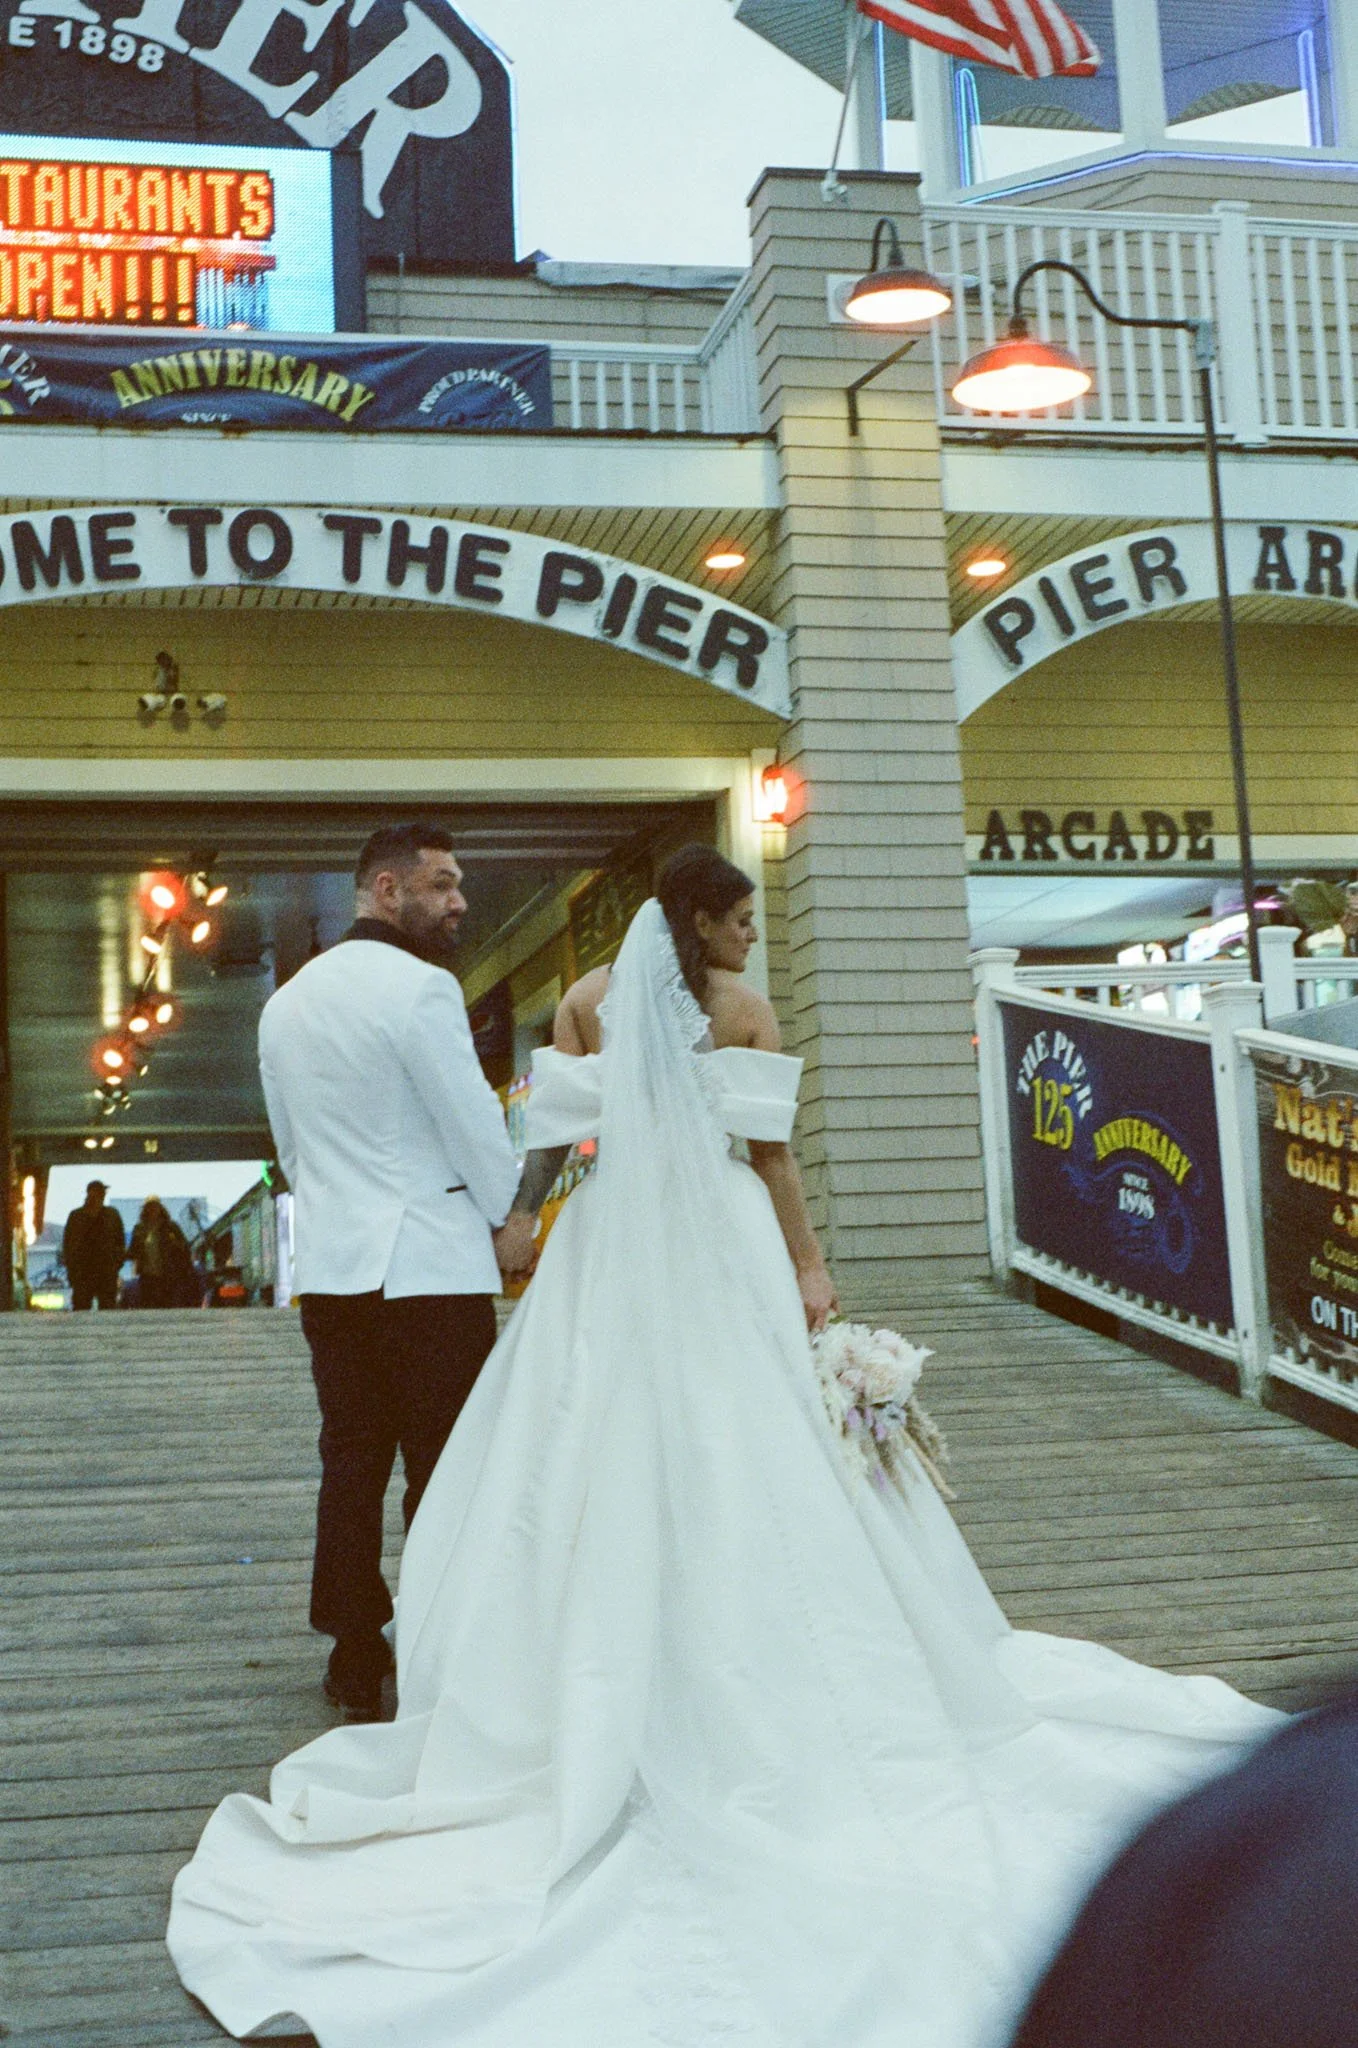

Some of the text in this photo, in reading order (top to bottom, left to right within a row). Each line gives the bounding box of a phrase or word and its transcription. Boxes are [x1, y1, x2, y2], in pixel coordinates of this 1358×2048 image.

[53, 19, 166, 73] 1898
[19, 0, 482, 219] ER
[0, 162, 274, 237] TAURANTS
[110, 347, 376, 422] ANNIVERSARY
[0, 508, 769, 689] ME TO THE PIER
[983, 525, 1358, 666] PIER AR
[978, 809, 1215, 861] ARCADE
[1016, 1030, 1094, 1120] THE PIER
[1032, 1076, 1075, 1150] 125
[1272, 1081, 1358, 1153] Nat'
[1093, 1118, 1193, 1187] ANNIVERSARY
[1286, 1141, 1343, 1193] Gold
[1118, 1186, 1155, 1220] 1898
[1311, 1294, 1338, 1332] ON
